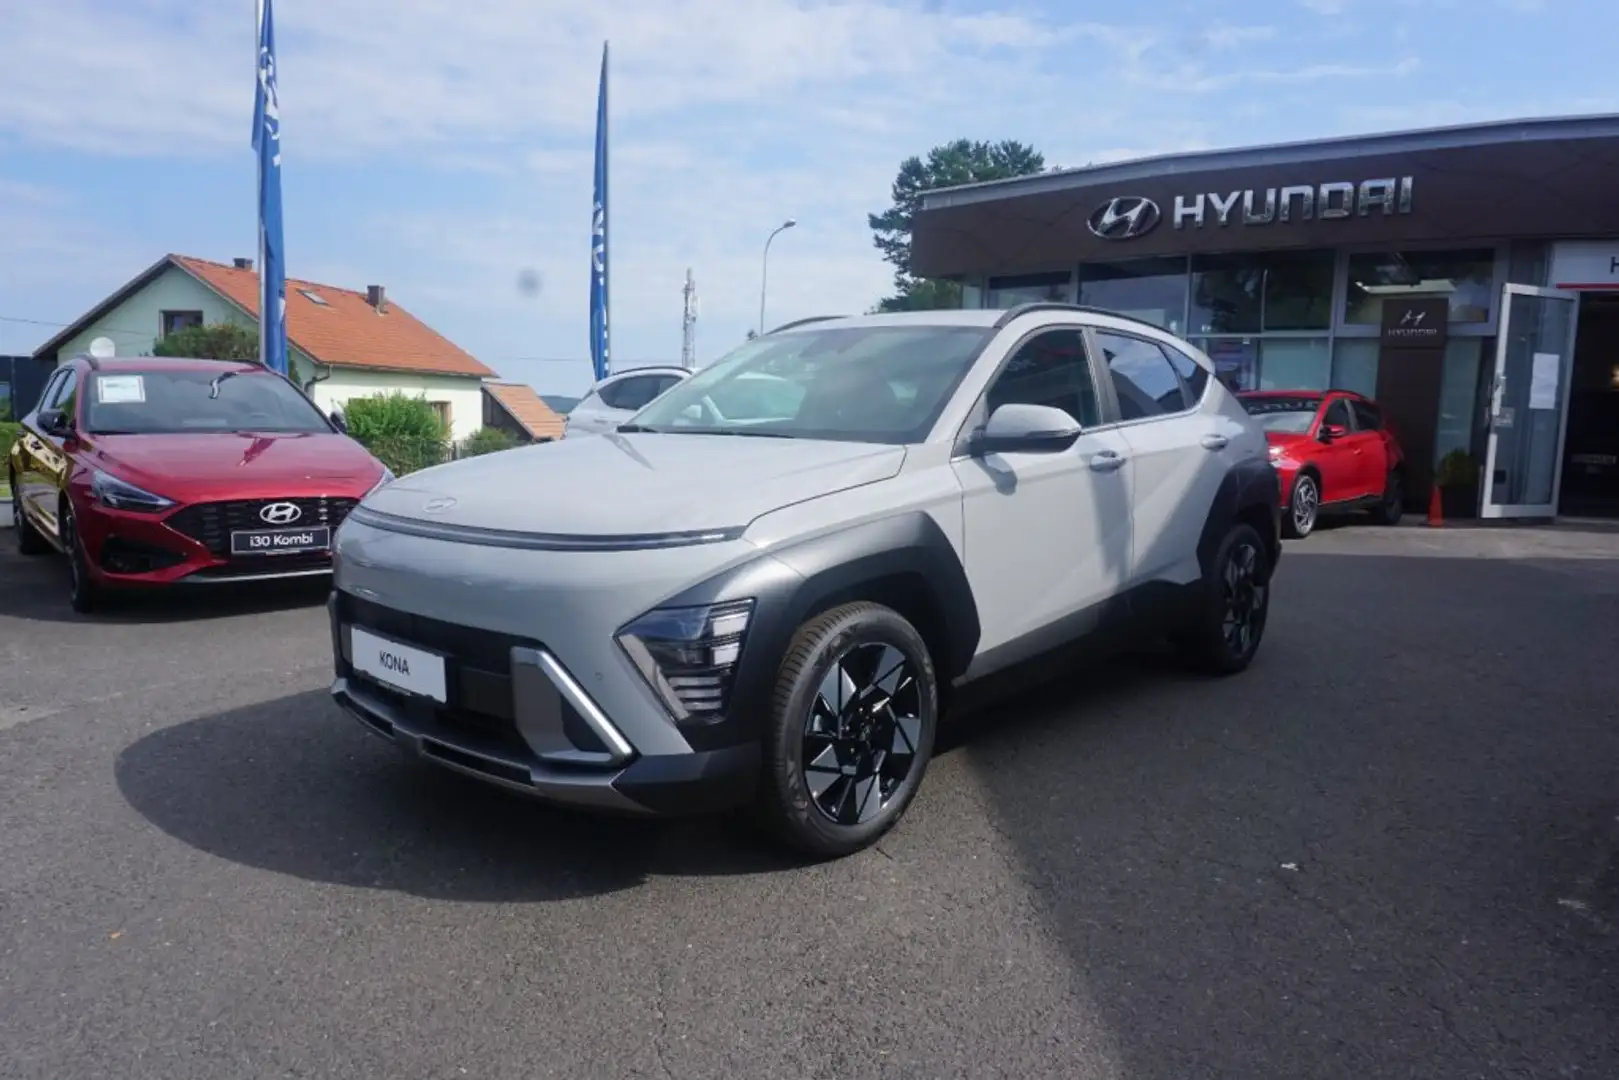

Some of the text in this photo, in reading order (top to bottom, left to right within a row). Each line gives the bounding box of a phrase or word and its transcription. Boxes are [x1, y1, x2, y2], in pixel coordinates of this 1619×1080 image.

[1173, 176, 1413, 229] HYUNDAI
[249, 532, 314, 547] i30 Kombi
[379, 650, 411, 676] KONA
